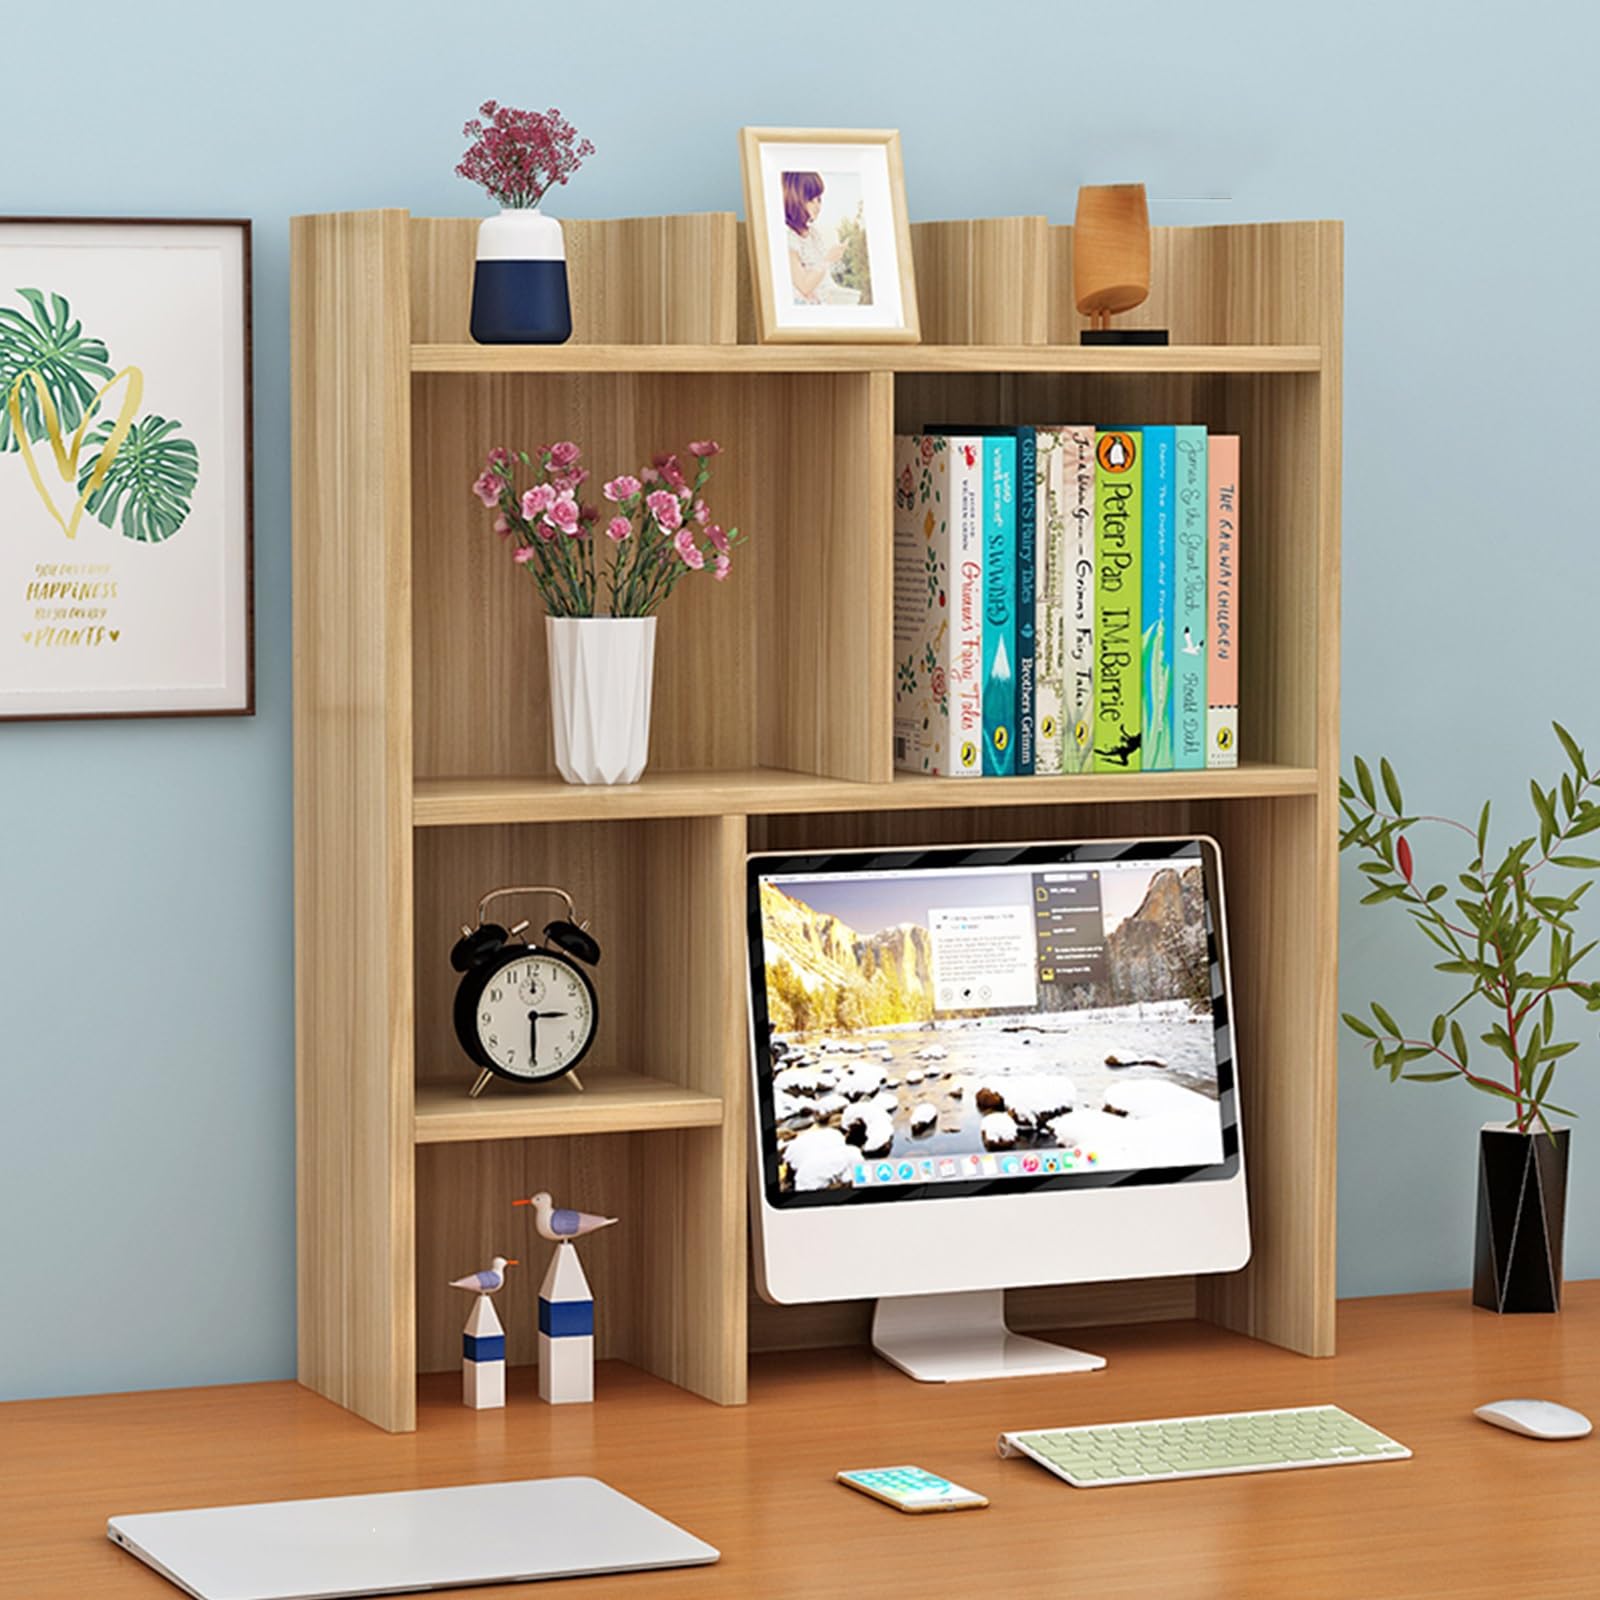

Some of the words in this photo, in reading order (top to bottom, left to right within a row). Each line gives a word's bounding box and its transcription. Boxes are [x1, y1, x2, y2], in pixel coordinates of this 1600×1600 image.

[1021, 438, 1034, 520] GRIMM'S
[1177, 439, 1205, 485] James
[1101, 479, 1134, 548] Peter
[1185, 507, 1201, 529] the
[1219, 484, 1236, 513] THE
[1018, 523, 1034, 563] Fairy
[1178, 532, 1204, 573] Giant
[1217, 519, 1235, 587] RAILWAY
[1021, 566, 1033, 604] Tales
[1101, 549, 1133, 593] Pan
[961, 561, 982, 632] Grimm's
[1071, 627, 1093, 661] Fairy
[1216, 590, 1231, 661] CHILDREN
[951, 635, 982, 683] Fairy
[1020, 657, 1034, 714] Brothers
[1075, 666, 1092, 708] Tales
[1182, 672, 1200, 715] Roald
[961, 683, 981, 731] Tales
[1020, 716, 1033, 765] Grimm
[1182, 717, 1201, 757] Dahl
[506, 970, 518, 985] 11
[526, 963, 540, 978] 12
[552, 967, 558, 982] 1
[567, 983, 577, 997] 2
[490, 988, 503, 1003] 10
[574, 1006, 584, 1020] 3
[481, 1012, 492, 1026] 9
[567, 1030, 576, 1043] 4
[488, 1034, 499, 1049] 8
[506, 1049, 516, 1064] 7
[553, 1046, 563, 1060] 5
